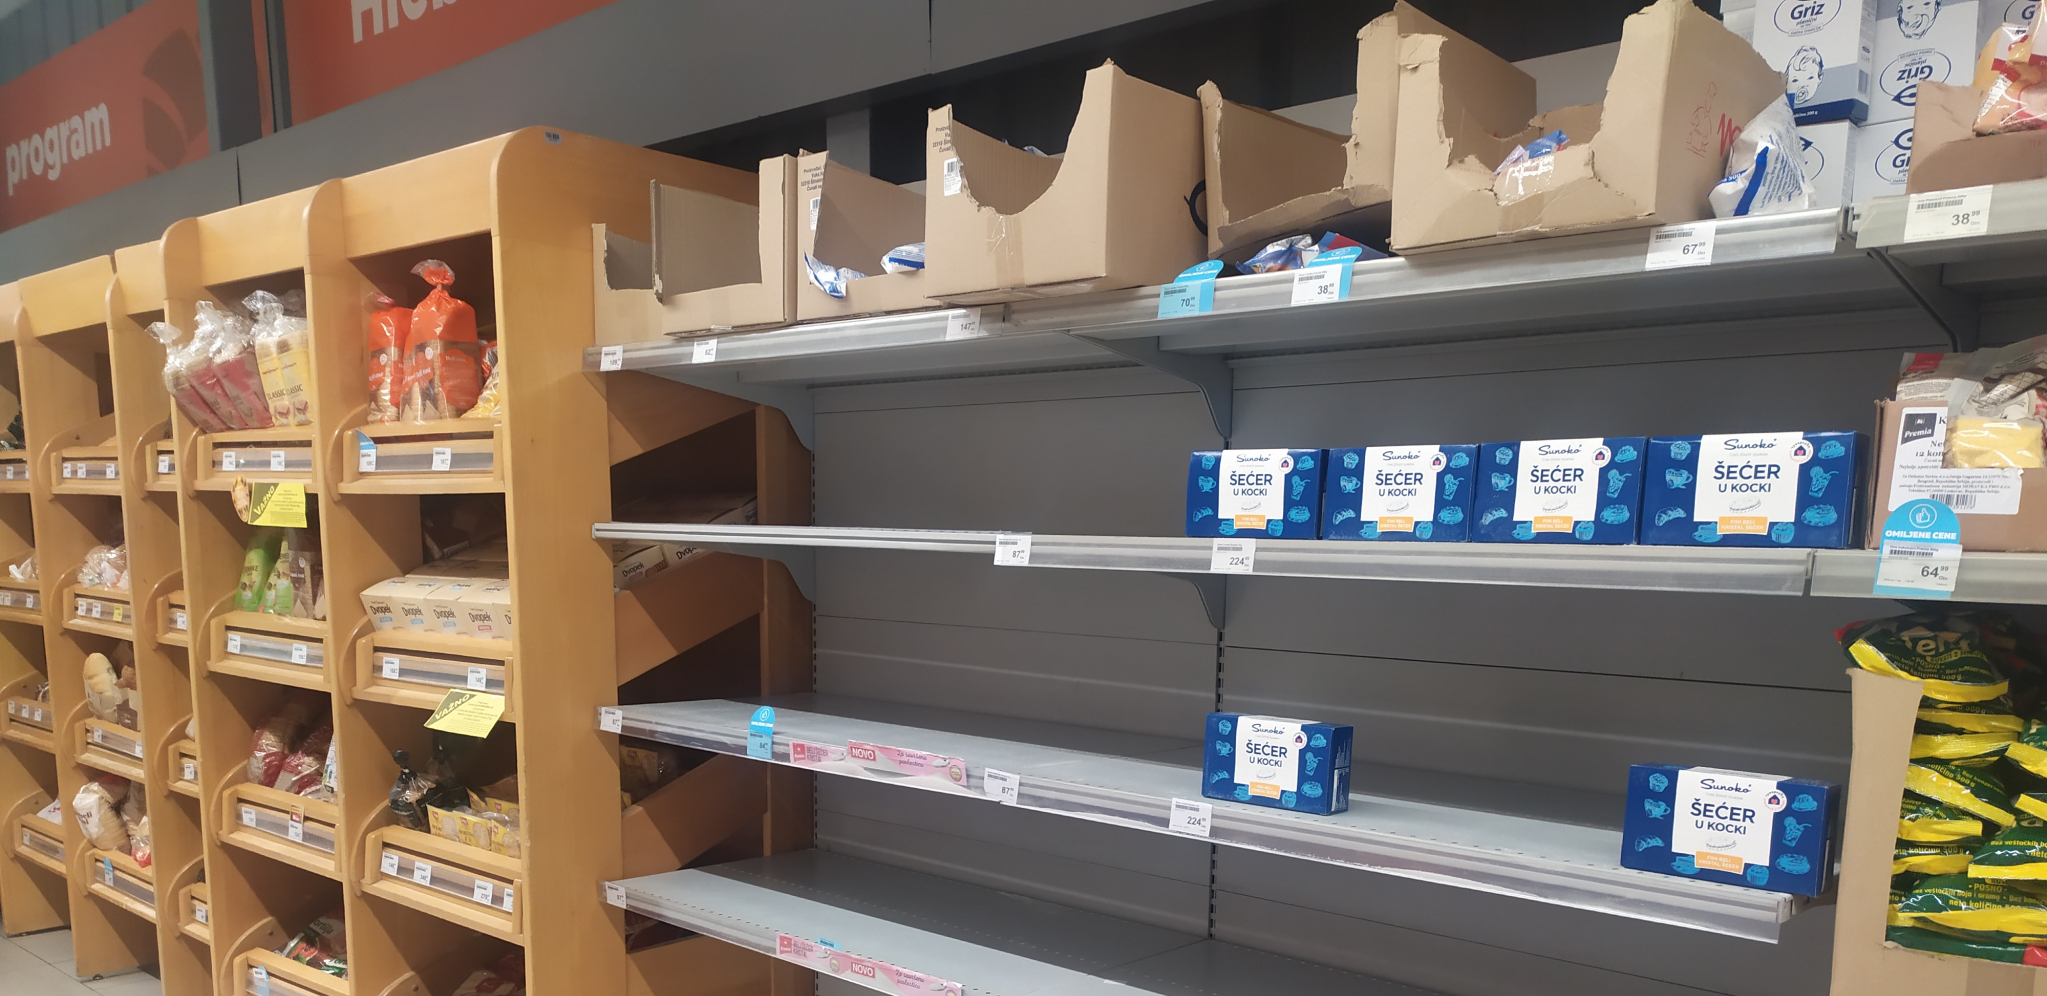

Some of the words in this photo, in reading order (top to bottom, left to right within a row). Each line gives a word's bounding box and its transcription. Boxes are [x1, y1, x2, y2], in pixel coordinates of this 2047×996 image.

[1790, 1, 1825, 20] Griz
[6, 102, 111, 196] program
[1951, 213, 1970, 226] 38
[1682, 244, 1698, 255] 67
[1317, 285, 1329, 295] 38
[1181, 298, 1191, 307] 70
[1904, 427, 1932, 438] Premia
[1538, 444, 1582, 456] Sunoko
[1723, 438, 1777, 451] Sunoko
[1236, 453, 1271, 463] Sunoko
[1382, 450, 1421, 461] Sunoko
[1530, 465, 1585, 483] ŠEĆER
[1713, 460, 1781, 480] ŠEĆER
[1229, 470, 1273, 486] ŠEĆER
[1375, 469, 1424, 486] ŠEĆER
[1233, 488, 1240, 496] U
[1241, 488, 1268, 496] KOCKI
[1378, 488, 1386, 497] U
[1387, 488, 1417, 497] KOCKI
[1534, 486, 1541, 495] U
[1543, 485, 1577, 495] KOCKI
[1718, 483, 1727, 493] U
[1730, 483, 1772, 493] KOCKI
[1885, 530, 1932, 539] OMILJENE
[1932, 532, 1957, 540] CENE
[1012, 550, 1021, 558] 87
[1229, 556, 1245, 566] 224
[1921, 565, 1940, 578] 64
[369, 604, 393, 616] Dvopek
[401, 605, 424, 618] Dvopek
[433, 608, 457, 620] Dvopek
[468, 611, 493, 624] Dvopek
[1251, 723, 1285, 735] Sunoko
[852, 747, 874, 760] NOVO
[1245, 739, 1288, 759] ŠEĆER
[1249, 756, 1256, 764] U
[1257, 757, 1283, 768] KOCKI
[1001, 786, 1010, 795] 87
[1700, 778, 1752, 794] Sunoko
[1690, 797, 1756, 824] ŠEĆER
[1187, 815, 1202, 827] 224
[1695, 819, 1704, 829] U
[1706, 821, 1747, 835] KOCKI
[1974, 883, 2003, 893] POSNO
[852, 963, 874, 977] NOVO
